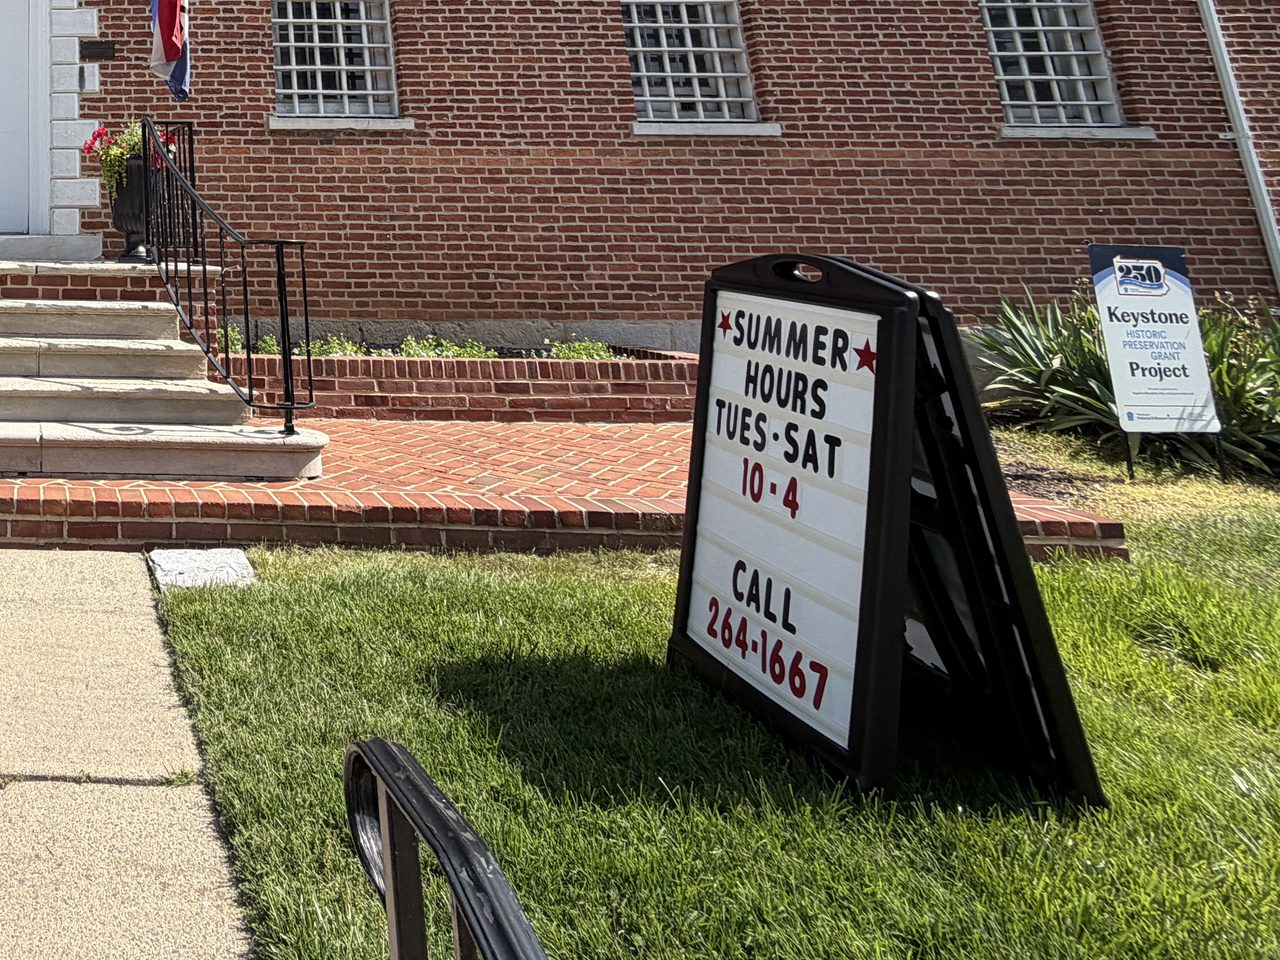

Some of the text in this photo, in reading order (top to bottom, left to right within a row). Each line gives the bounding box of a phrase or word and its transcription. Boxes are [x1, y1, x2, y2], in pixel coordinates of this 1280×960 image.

[1118, 264, 1162, 283] 250
[1107, 306, 1189, 327] Keystone
[732, 309, 850, 372] SUMMER
[1126, 329, 1166, 339] HISTORIC
[1122, 340, 1186, 350] PRESERVATION
[1150, 351, 1180, 361] GRANT
[1129, 362, 1190, 382] Project
[744, 358, 828, 420] HOURS
[732, 559, 797, 635] CALL
[706, 596, 828, 711] 264-1667
